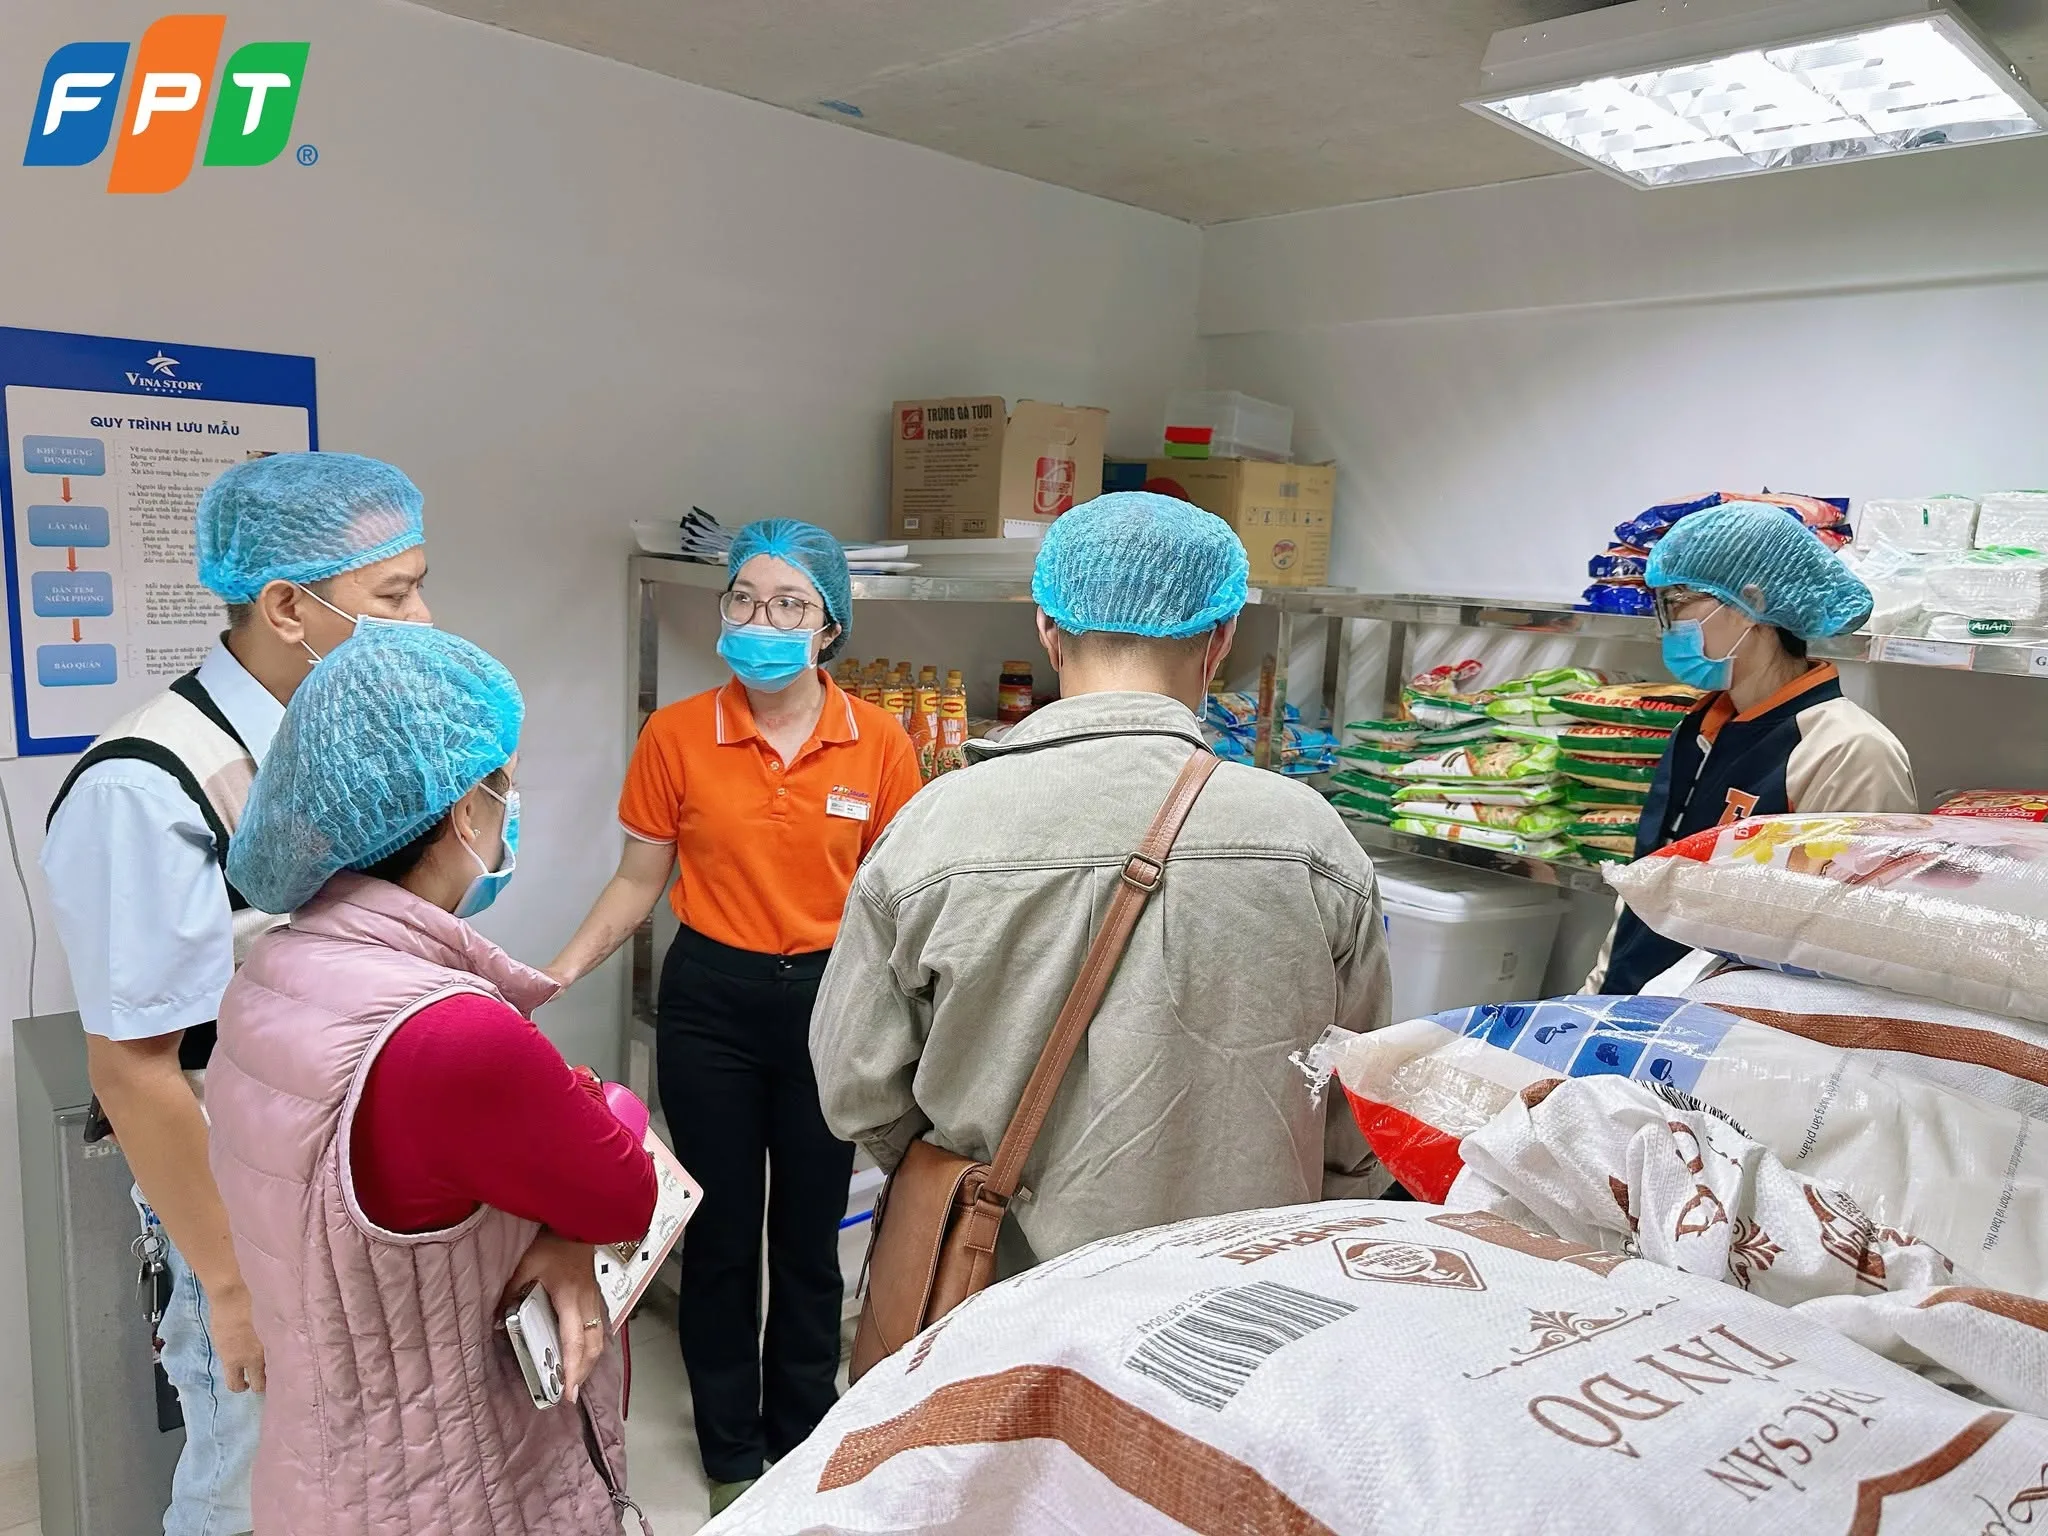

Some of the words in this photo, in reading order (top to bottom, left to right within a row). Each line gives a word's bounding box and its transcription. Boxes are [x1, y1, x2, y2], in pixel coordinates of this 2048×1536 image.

[125, 372, 161, 388] VINA
[162, 380, 203, 391] STORY
[90, 416, 124, 429] QUY
[128, 417, 172, 432] TRÌNH
[177, 421, 203, 433] LƯU
[208, 420, 241, 436] MẪU
[928, 429, 948, 441] Fresh
[1971, 621, 2008, 632] AnAn
[1634, 1323, 1798, 1395] TÂY
[1528, 1372, 1684, 1459] ĐÔ
[1704, 1424, 1812, 1501] SẢN
